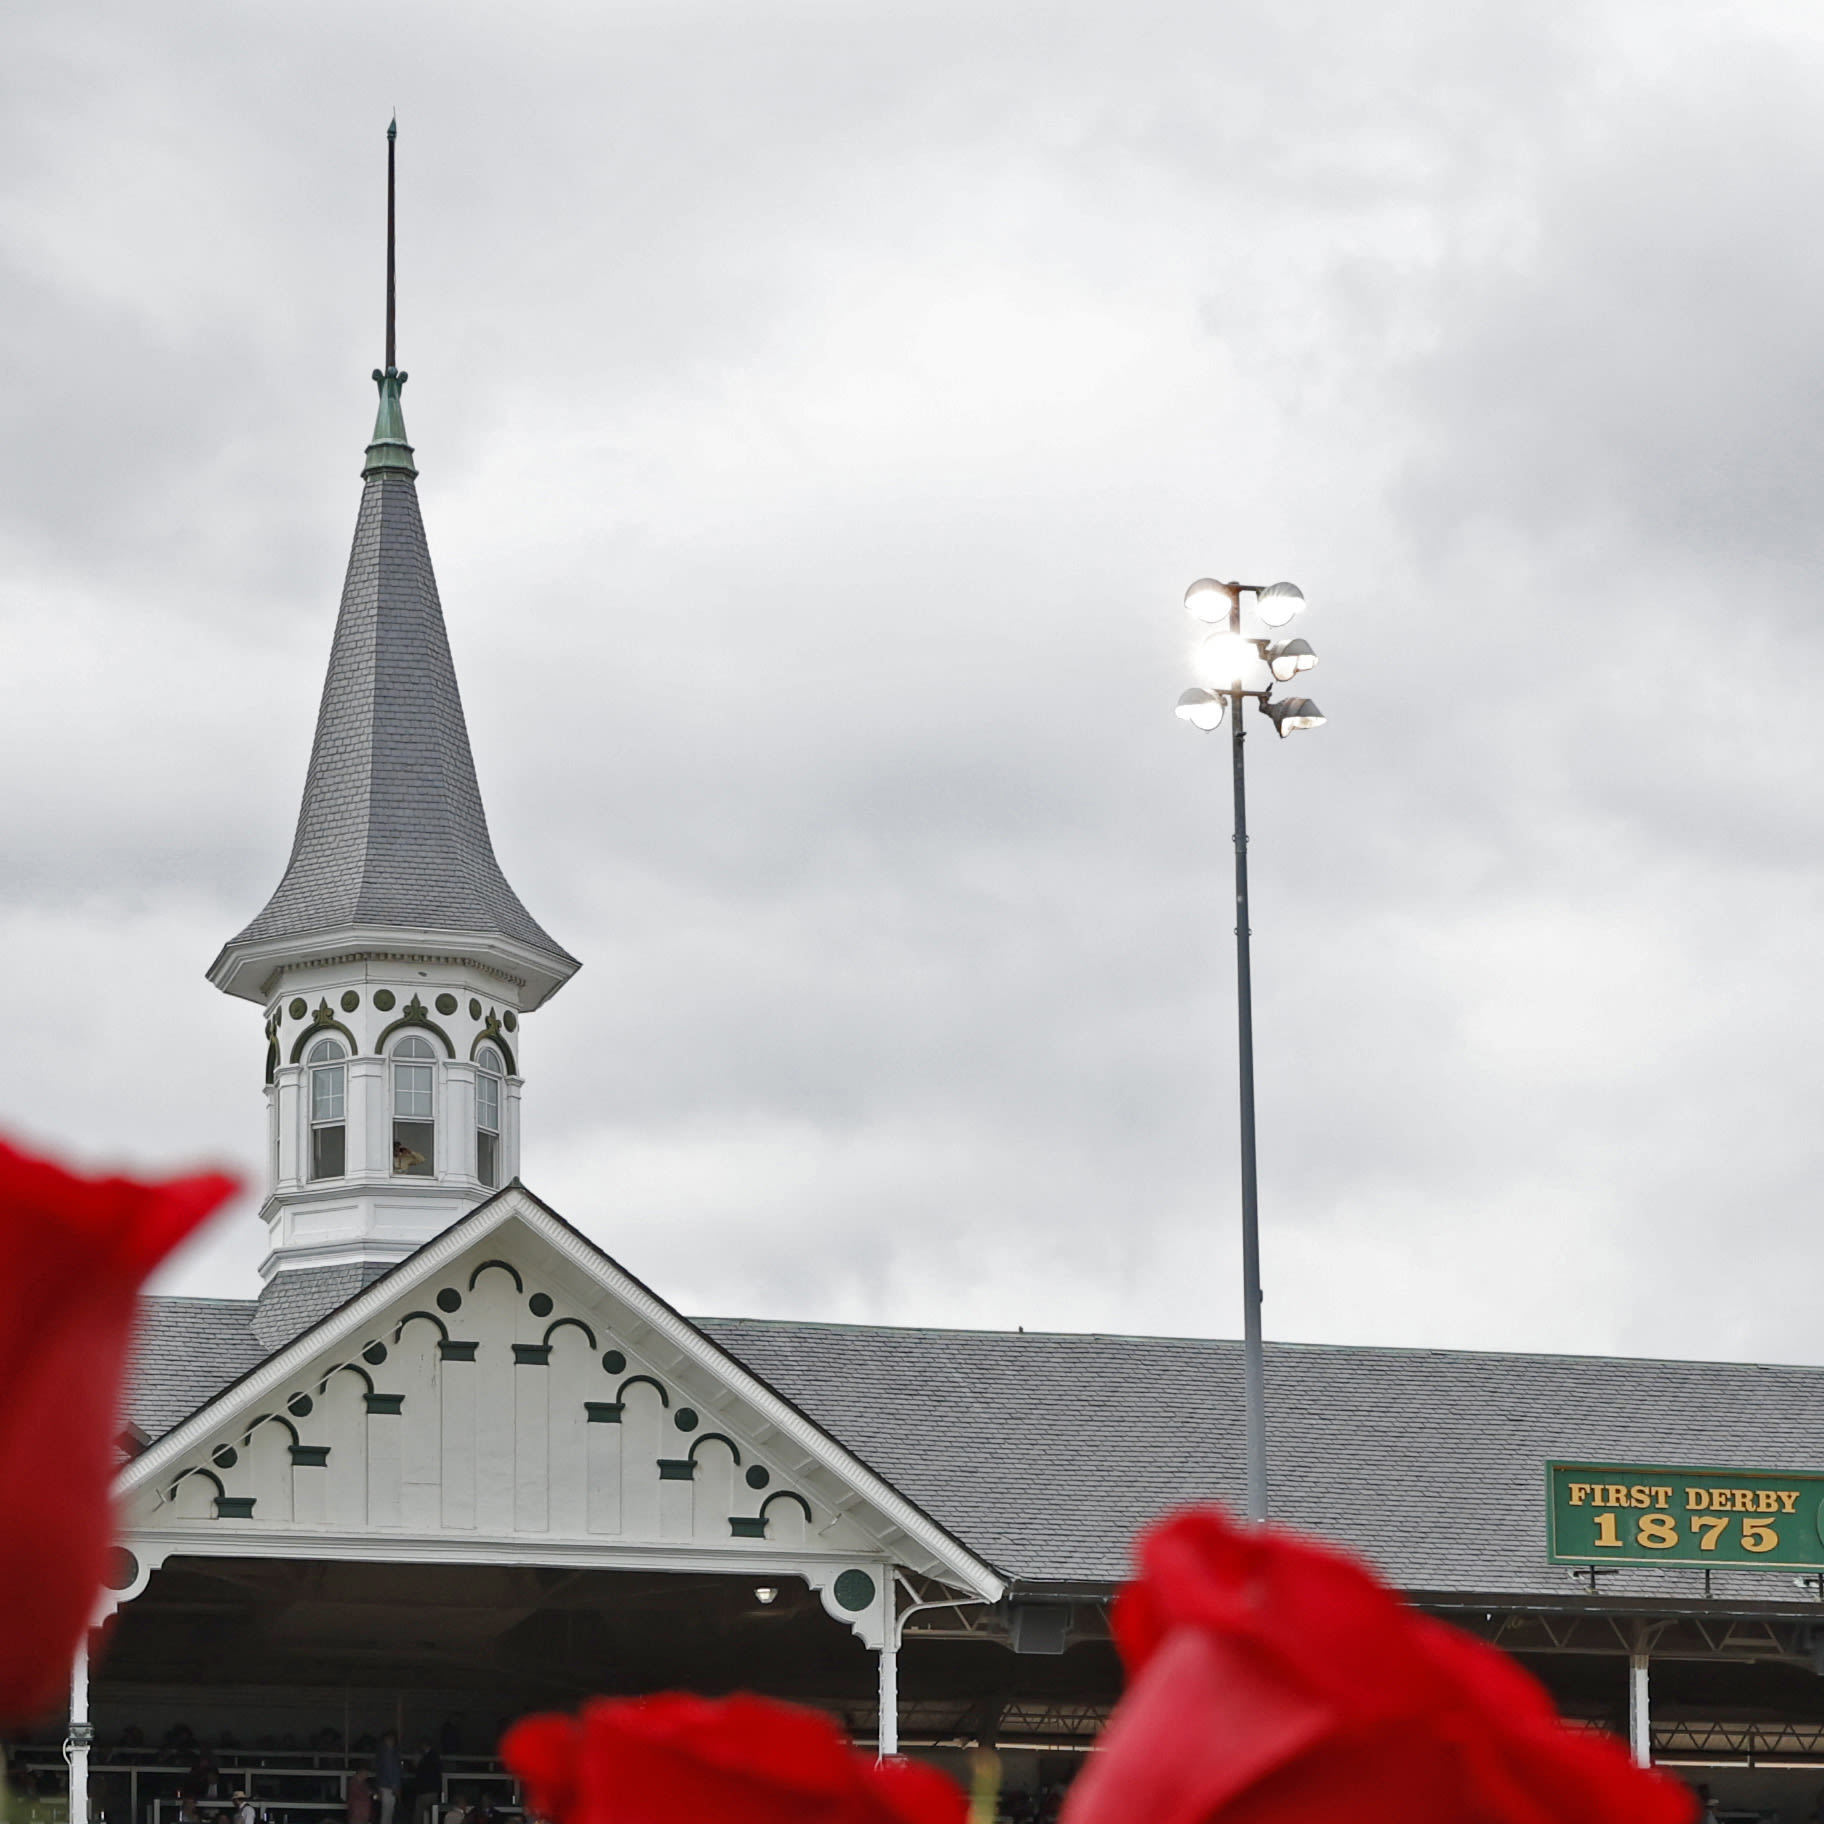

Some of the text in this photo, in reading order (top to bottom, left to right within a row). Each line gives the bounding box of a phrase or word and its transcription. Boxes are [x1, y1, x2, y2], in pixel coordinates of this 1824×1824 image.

[1568, 1483, 1800, 1513] FIRST DERBY
[1593, 1512, 1780, 1553] 1875
